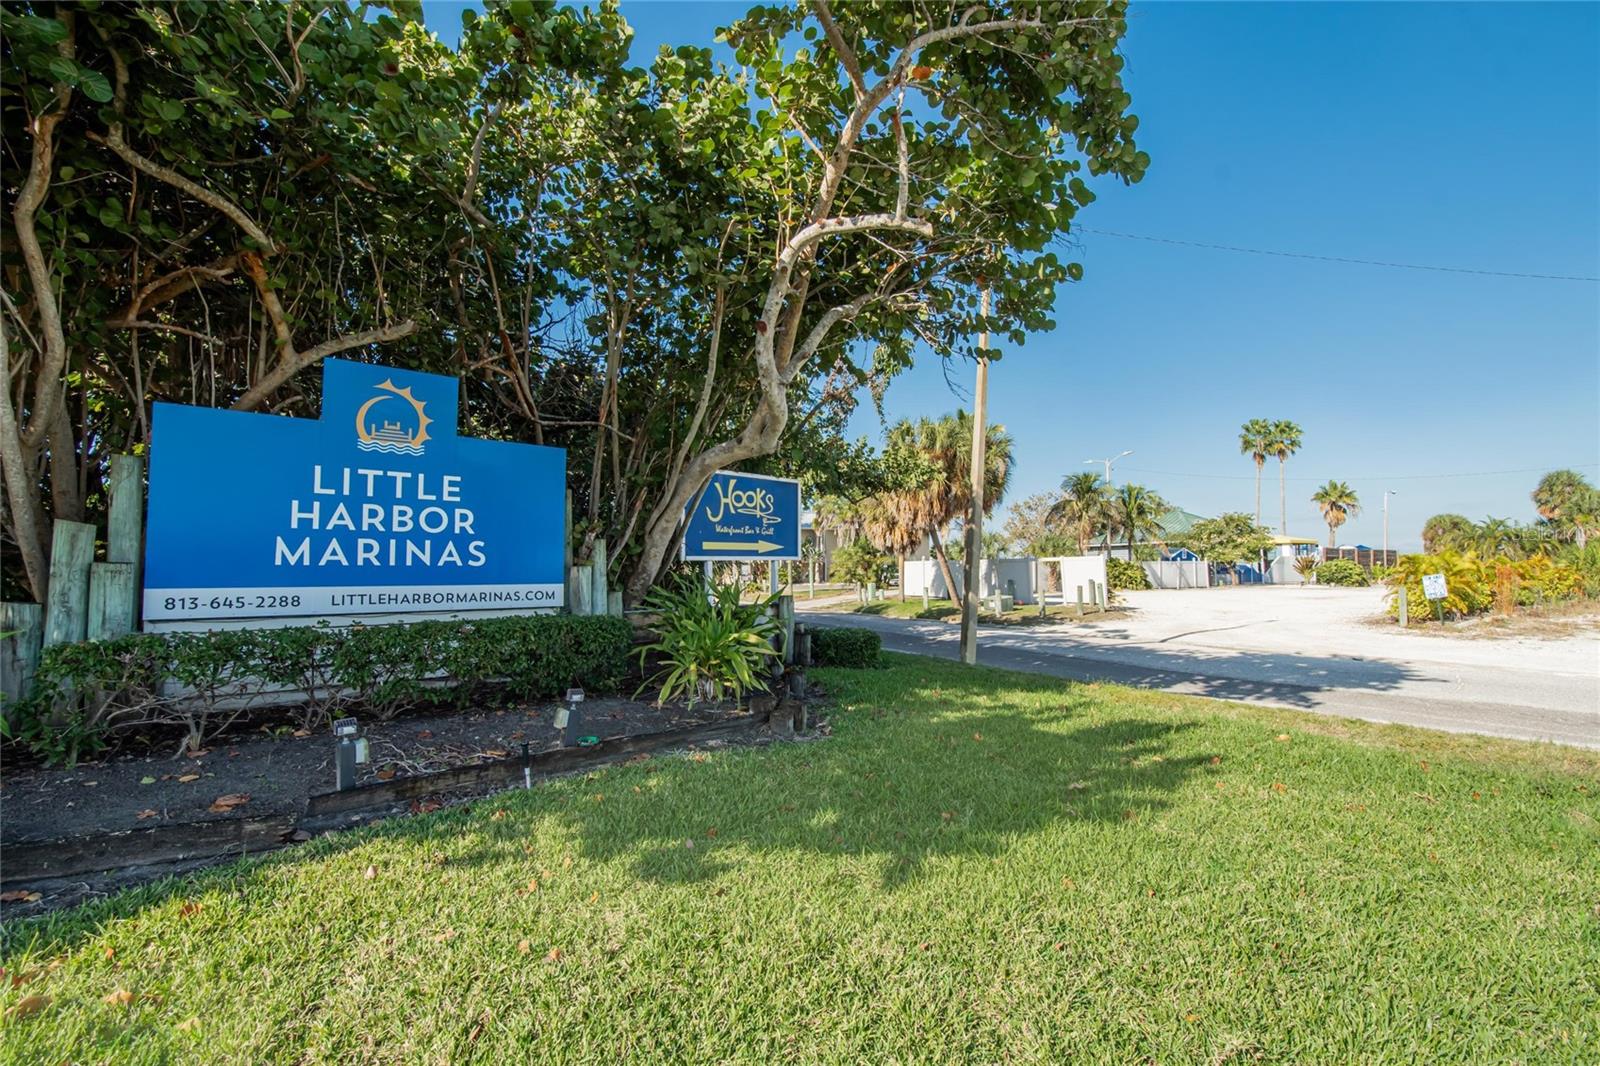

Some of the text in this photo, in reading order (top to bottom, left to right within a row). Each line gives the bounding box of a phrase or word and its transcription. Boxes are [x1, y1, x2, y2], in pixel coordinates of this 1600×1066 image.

[313, 465, 462, 502] LITTLE
[290, 500, 475, 534] HARBOR
[715, 524, 744, 536] Waterfront
[274, 536, 487, 567] MARINAS
[164, 595, 302, 611] 813-645-2288
[331, 590, 556, 607] LITTLEHARBORMARINAS.COM
